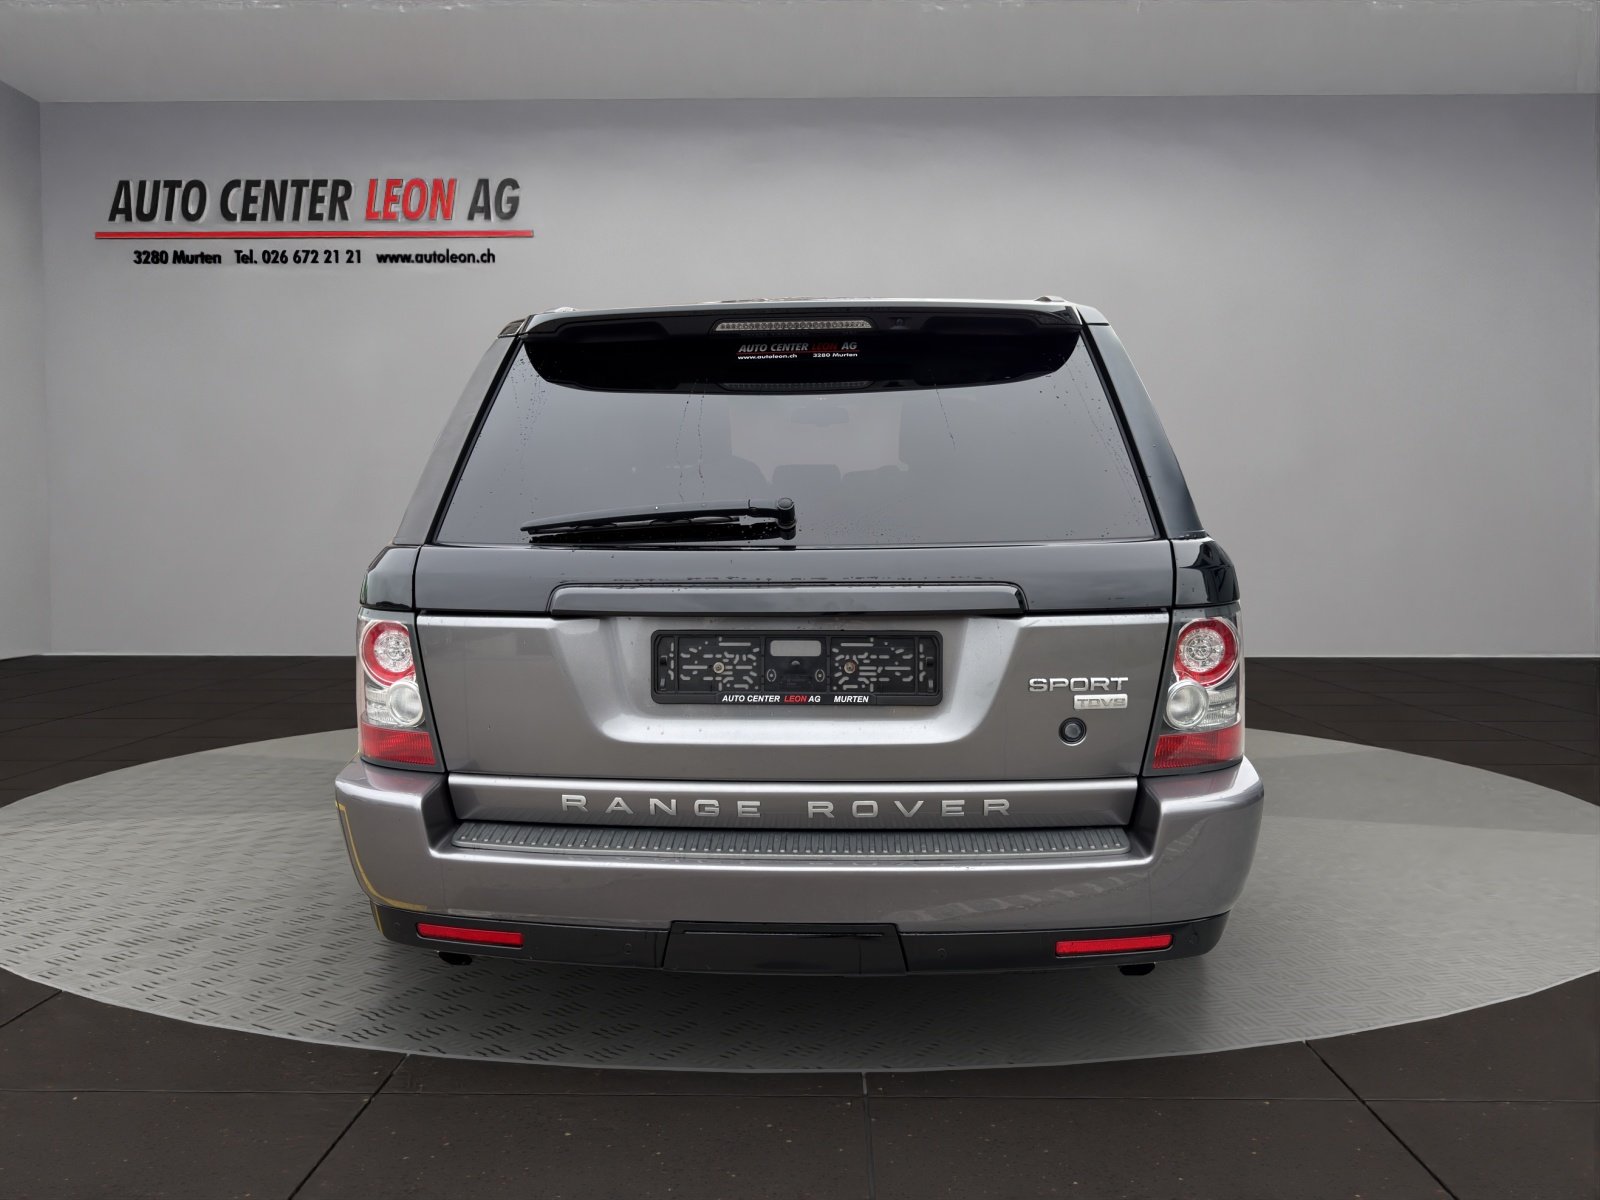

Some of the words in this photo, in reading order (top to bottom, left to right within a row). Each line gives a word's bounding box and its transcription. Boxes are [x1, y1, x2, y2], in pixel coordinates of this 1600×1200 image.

[108, 179, 207, 222] AUTO
[219, 179, 353, 222] CENTER
[365, 178, 457, 221] LEON
[467, 177, 521, 221] AG
[133, 250, 168, 265] 3280
[172, 250, 221, 265] Murten
[234, 249, 257, 265] Tel.
[261, 249, 288, 265] 026
[292, 249, 319, 265] 672
[323, 249, 340, 264] 21
[345, 249, 362, 264] 21
[376, 248, 495, 265] www.autoleon.ch
[738, 344, 768, 353] AUTO
[770, 343, 809, 352] CENTER
[841, 342, 857, 350] AG
[1029, 677, 1129, 692] SPORT
[747, 694, 780, 703] CENTER
[783, 694, 807, 702] LEON
[808, 694, 821, 703] AG
[833, 695, 869, 703] MURTEN
[561, 794, 761, 818] RANGE
[807, 799, 1010, 819] ROVER
